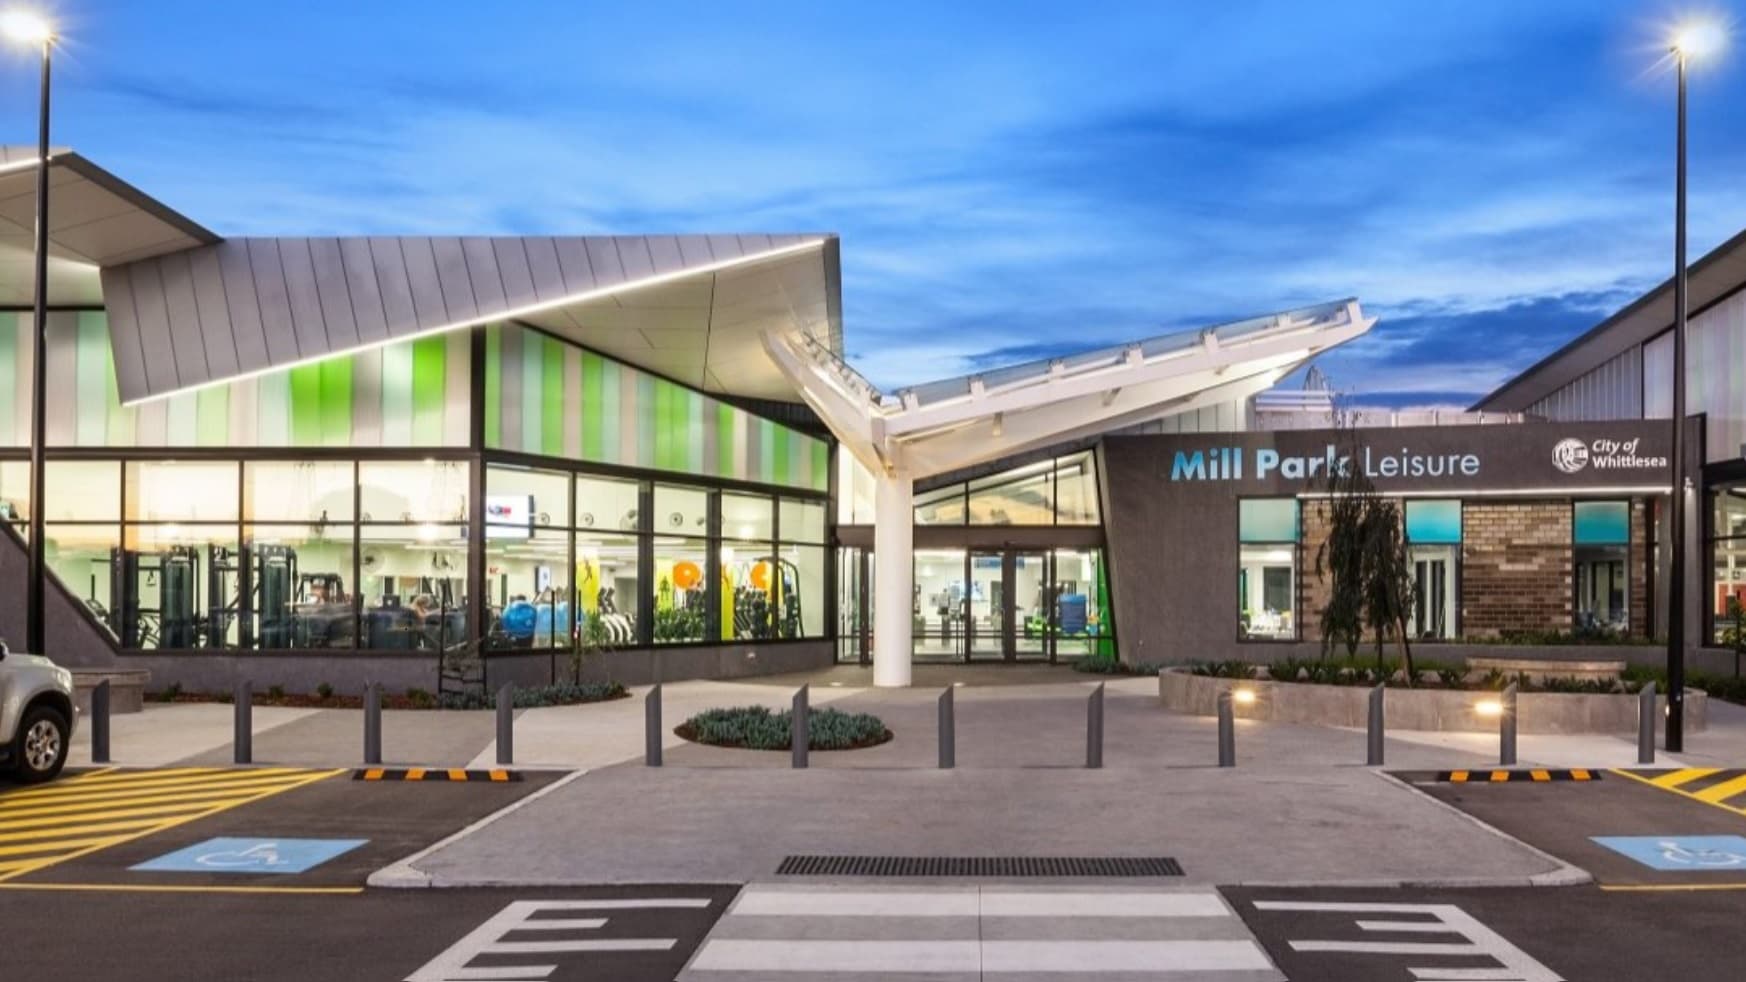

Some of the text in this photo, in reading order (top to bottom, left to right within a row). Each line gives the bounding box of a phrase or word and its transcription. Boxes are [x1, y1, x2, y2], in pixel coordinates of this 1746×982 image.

[1592, 437, 1640, 456] City of
[1171, 445, 1480, 481] Mill Park Leisure
[1592, 455, 1667, 468] Whittlesea
